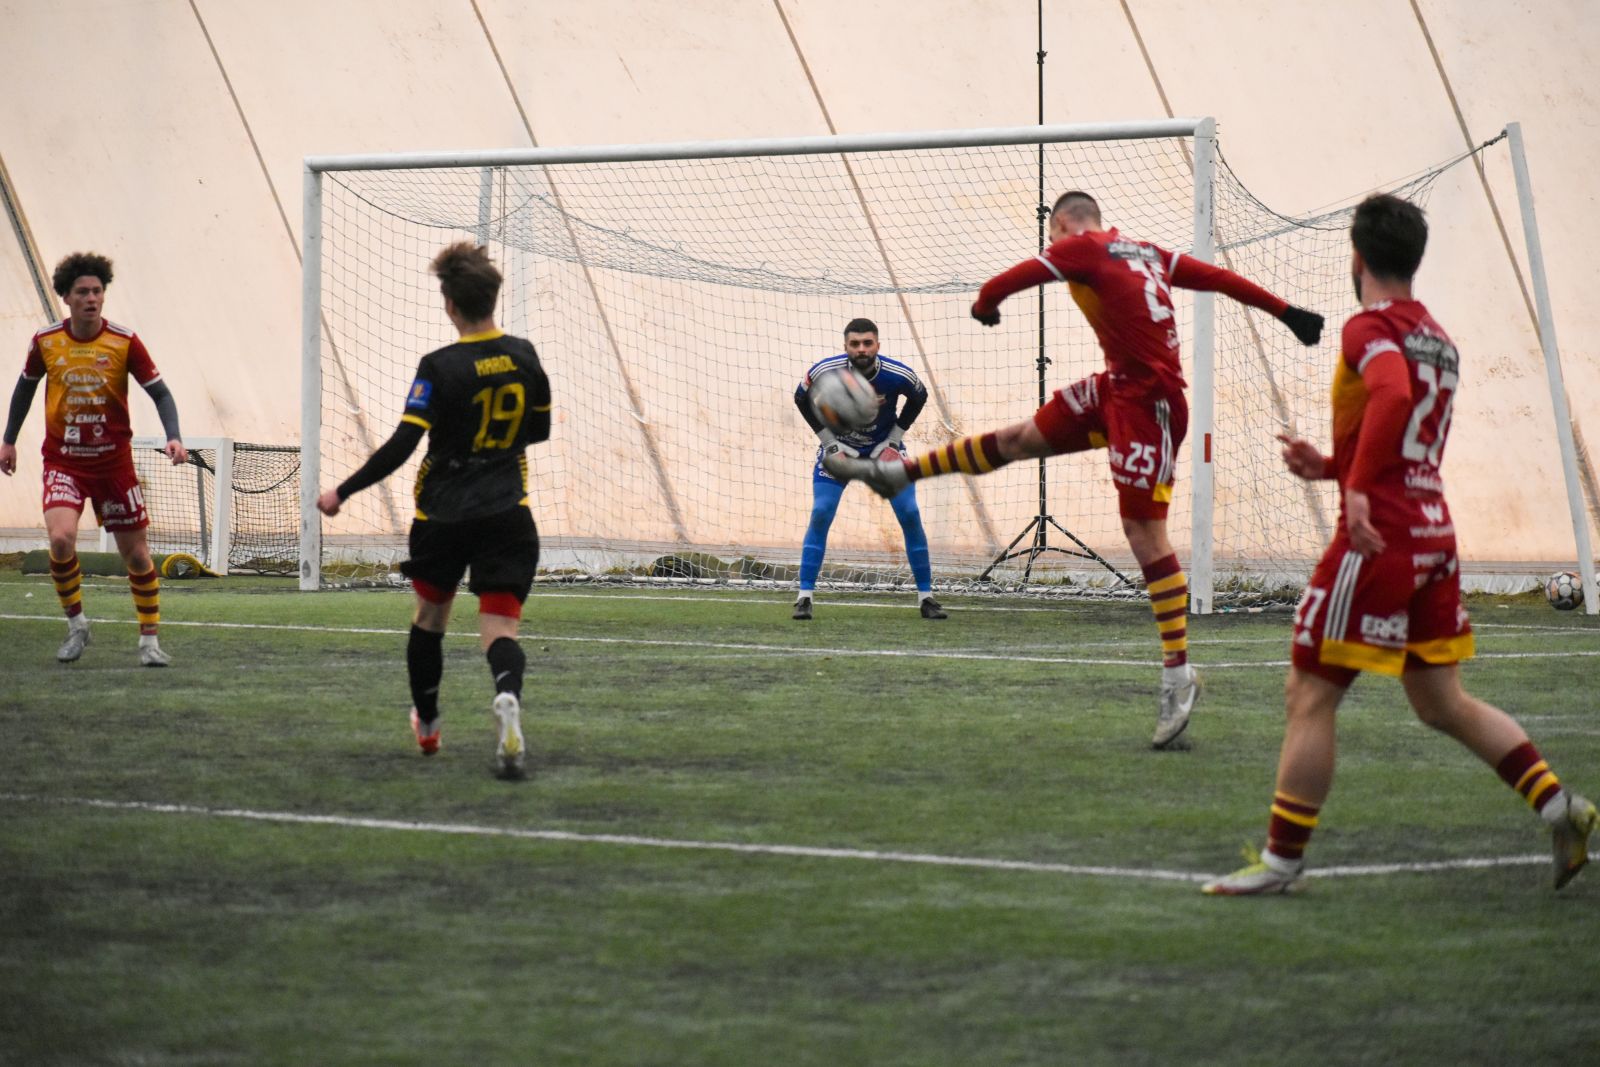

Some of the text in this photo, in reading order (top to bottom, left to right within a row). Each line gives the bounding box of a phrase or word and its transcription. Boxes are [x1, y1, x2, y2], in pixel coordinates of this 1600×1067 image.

[472, 383, 525, 452] 19
[1402, 363, 1458, 467] 27
[1125, 441, 1156, 475] 25
